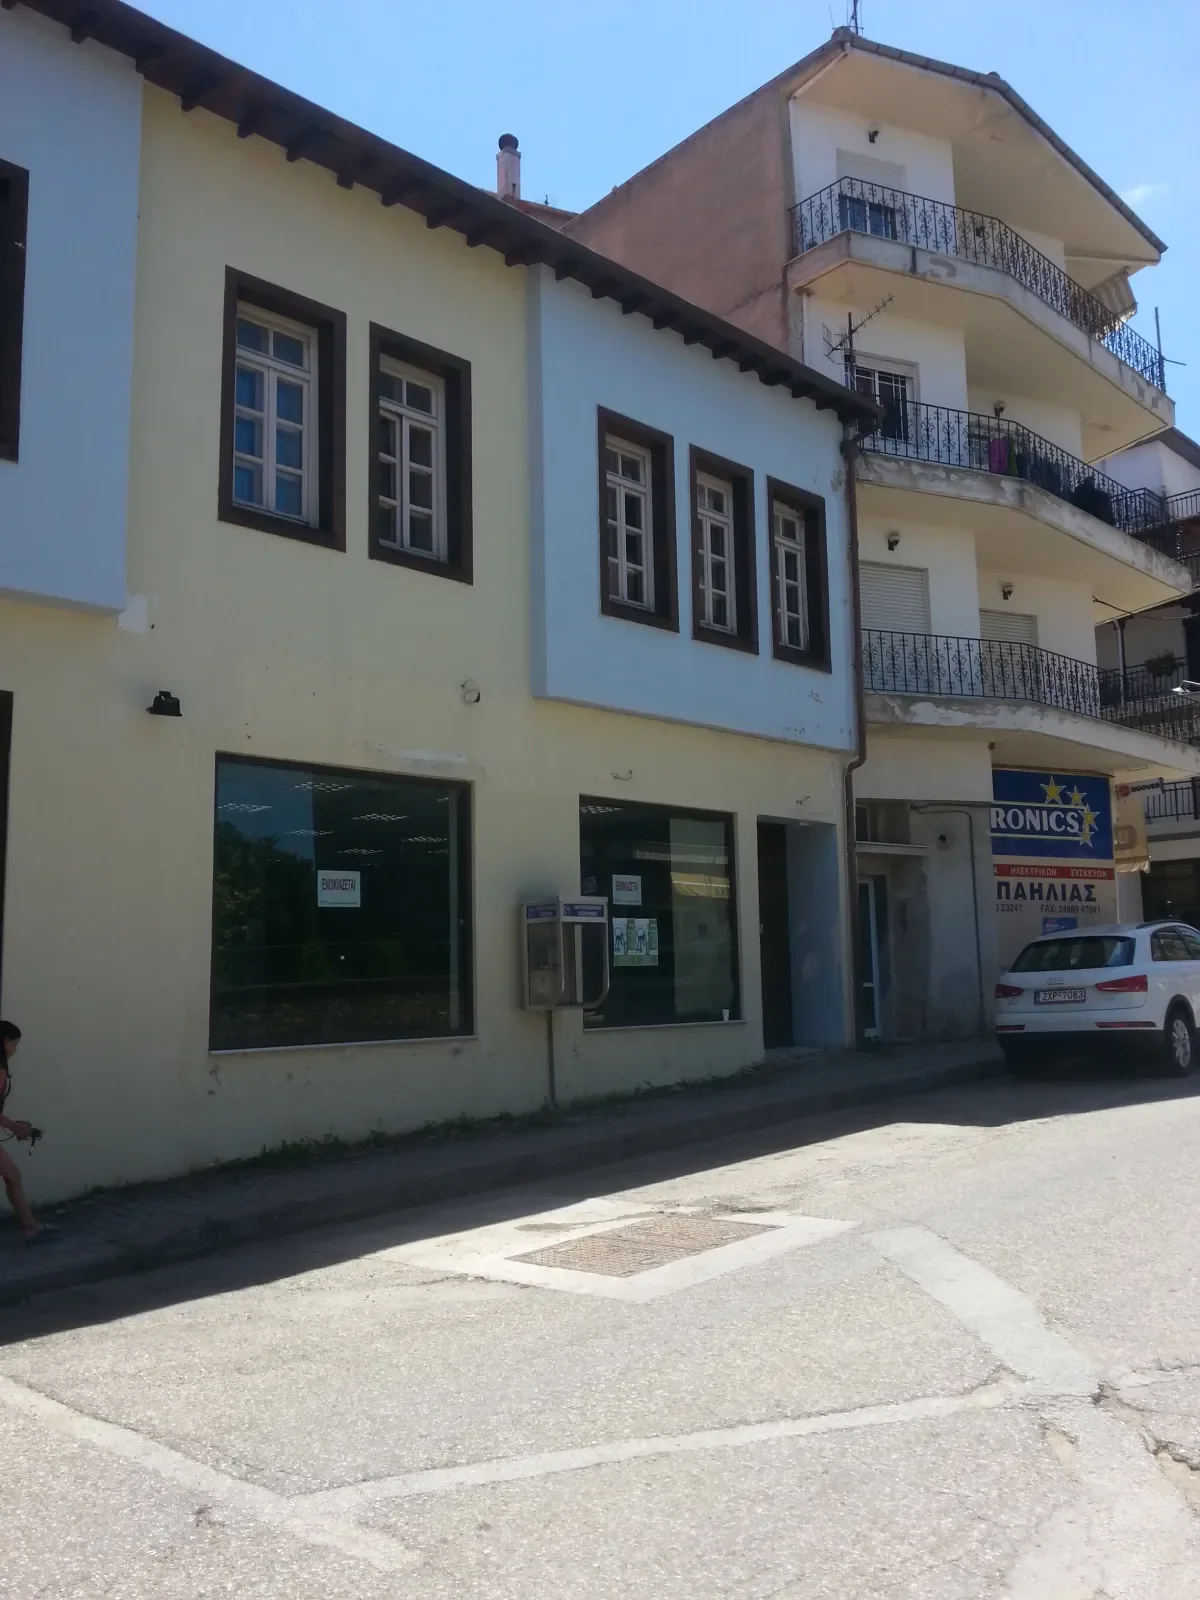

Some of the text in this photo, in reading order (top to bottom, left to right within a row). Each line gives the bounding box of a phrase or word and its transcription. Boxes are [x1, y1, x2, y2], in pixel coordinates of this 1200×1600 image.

[1131, 782, 1160, 792] HOOVER
[990, 808, 1080, 833] RONICS
[1010, 867, 1057, 876] ΗΛΕΚΤΡΙΚΩΝ
[1070, 868, 1107, 878] ΣΥΣΚΕΥΩΝ
[997, 881, 1097, 902] ΠΑΗΛΙΑΣ
[1001, 904, 1022, 912] 23241
[1040, 904, 1057, 913] FAX:
